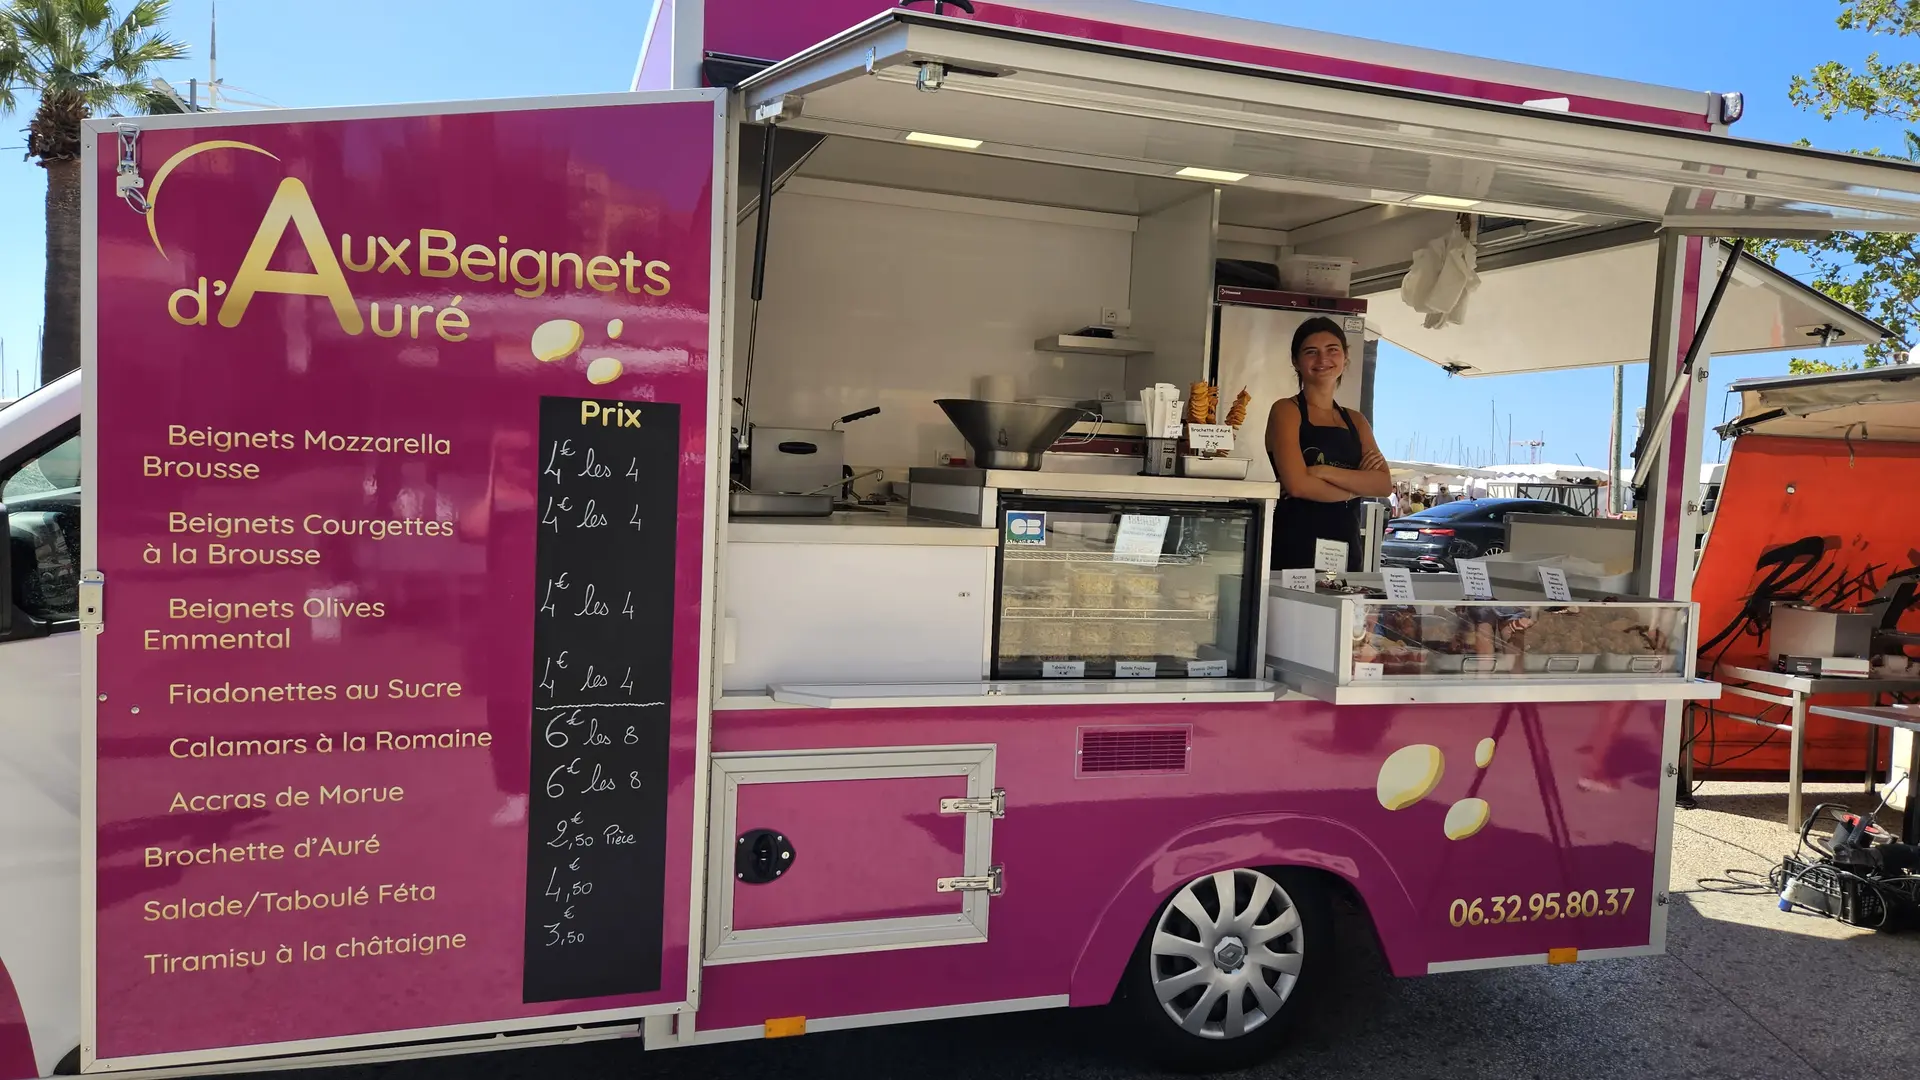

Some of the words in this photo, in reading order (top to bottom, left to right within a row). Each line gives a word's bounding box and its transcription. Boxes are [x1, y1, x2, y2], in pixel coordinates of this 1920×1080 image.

[419, 227, 672, 300] Beignets
[581, 401, 641, 428] Prix
[169, 425, 294, 452] Beignets
[305, 430, 450, 454] Mozzarella
[144, 456, 259, 479] Brousse
[578, 448, 611, 477] les
[626, 457, 638, 482] 4
[170, 512, 294, 538] Beignets
[303, 513, 454, 541] Courgettes
[577, 499, 607, 528] les
[630, 504, 641, 531] 4
[143, 543, 160, 563] à
[173, 543, 196, 564] la
[209, 544, 320, 564] Brousse
[170, 599, 294, 623] Beignets
[302, 596, 387, 621] Olives
[574, 584, 609, 616] les
[622, 591, 633, 619] 4
[145, 628, 290, 650] Emmental
[170, 682, 336, 704] Fiadonettes
[346, 685, 378, 699] au
[388, 679, 461, 698] Sucre
[580, 665, 607, 691] les
[620, 667, 633, 695] 4
[170, 736, 307, 758] Calamars
[317, 733, 332, 752] à
[344, 732, 365, 751] la
[377, 729, 492, 750] Romaine
[582, 718, 611, 745] les
[624, 726, 638, 744] 8
[581, 763, 615, 793] les
[630, 771, 641, 789] 8
[169, 792, 266, 812] Accras
[276, 786, 309, 806] de
[320, 785, 403, 804] Morue
[145, 843, 284, 867] Brochette
[294, 834, 380, 858] d'Auré
[144, 886, 368, 921] Salade/Taboulé
[380, 883, 435, 903] Féta
[1450, 888, 1635, 926] 06.32.95.80.37
[144, 949, 265, 974] Tiramisu
[276, 944, 292, 963] à
[304, 941, 325, 961] la
[336, 934, 466, 958] châtaigne
